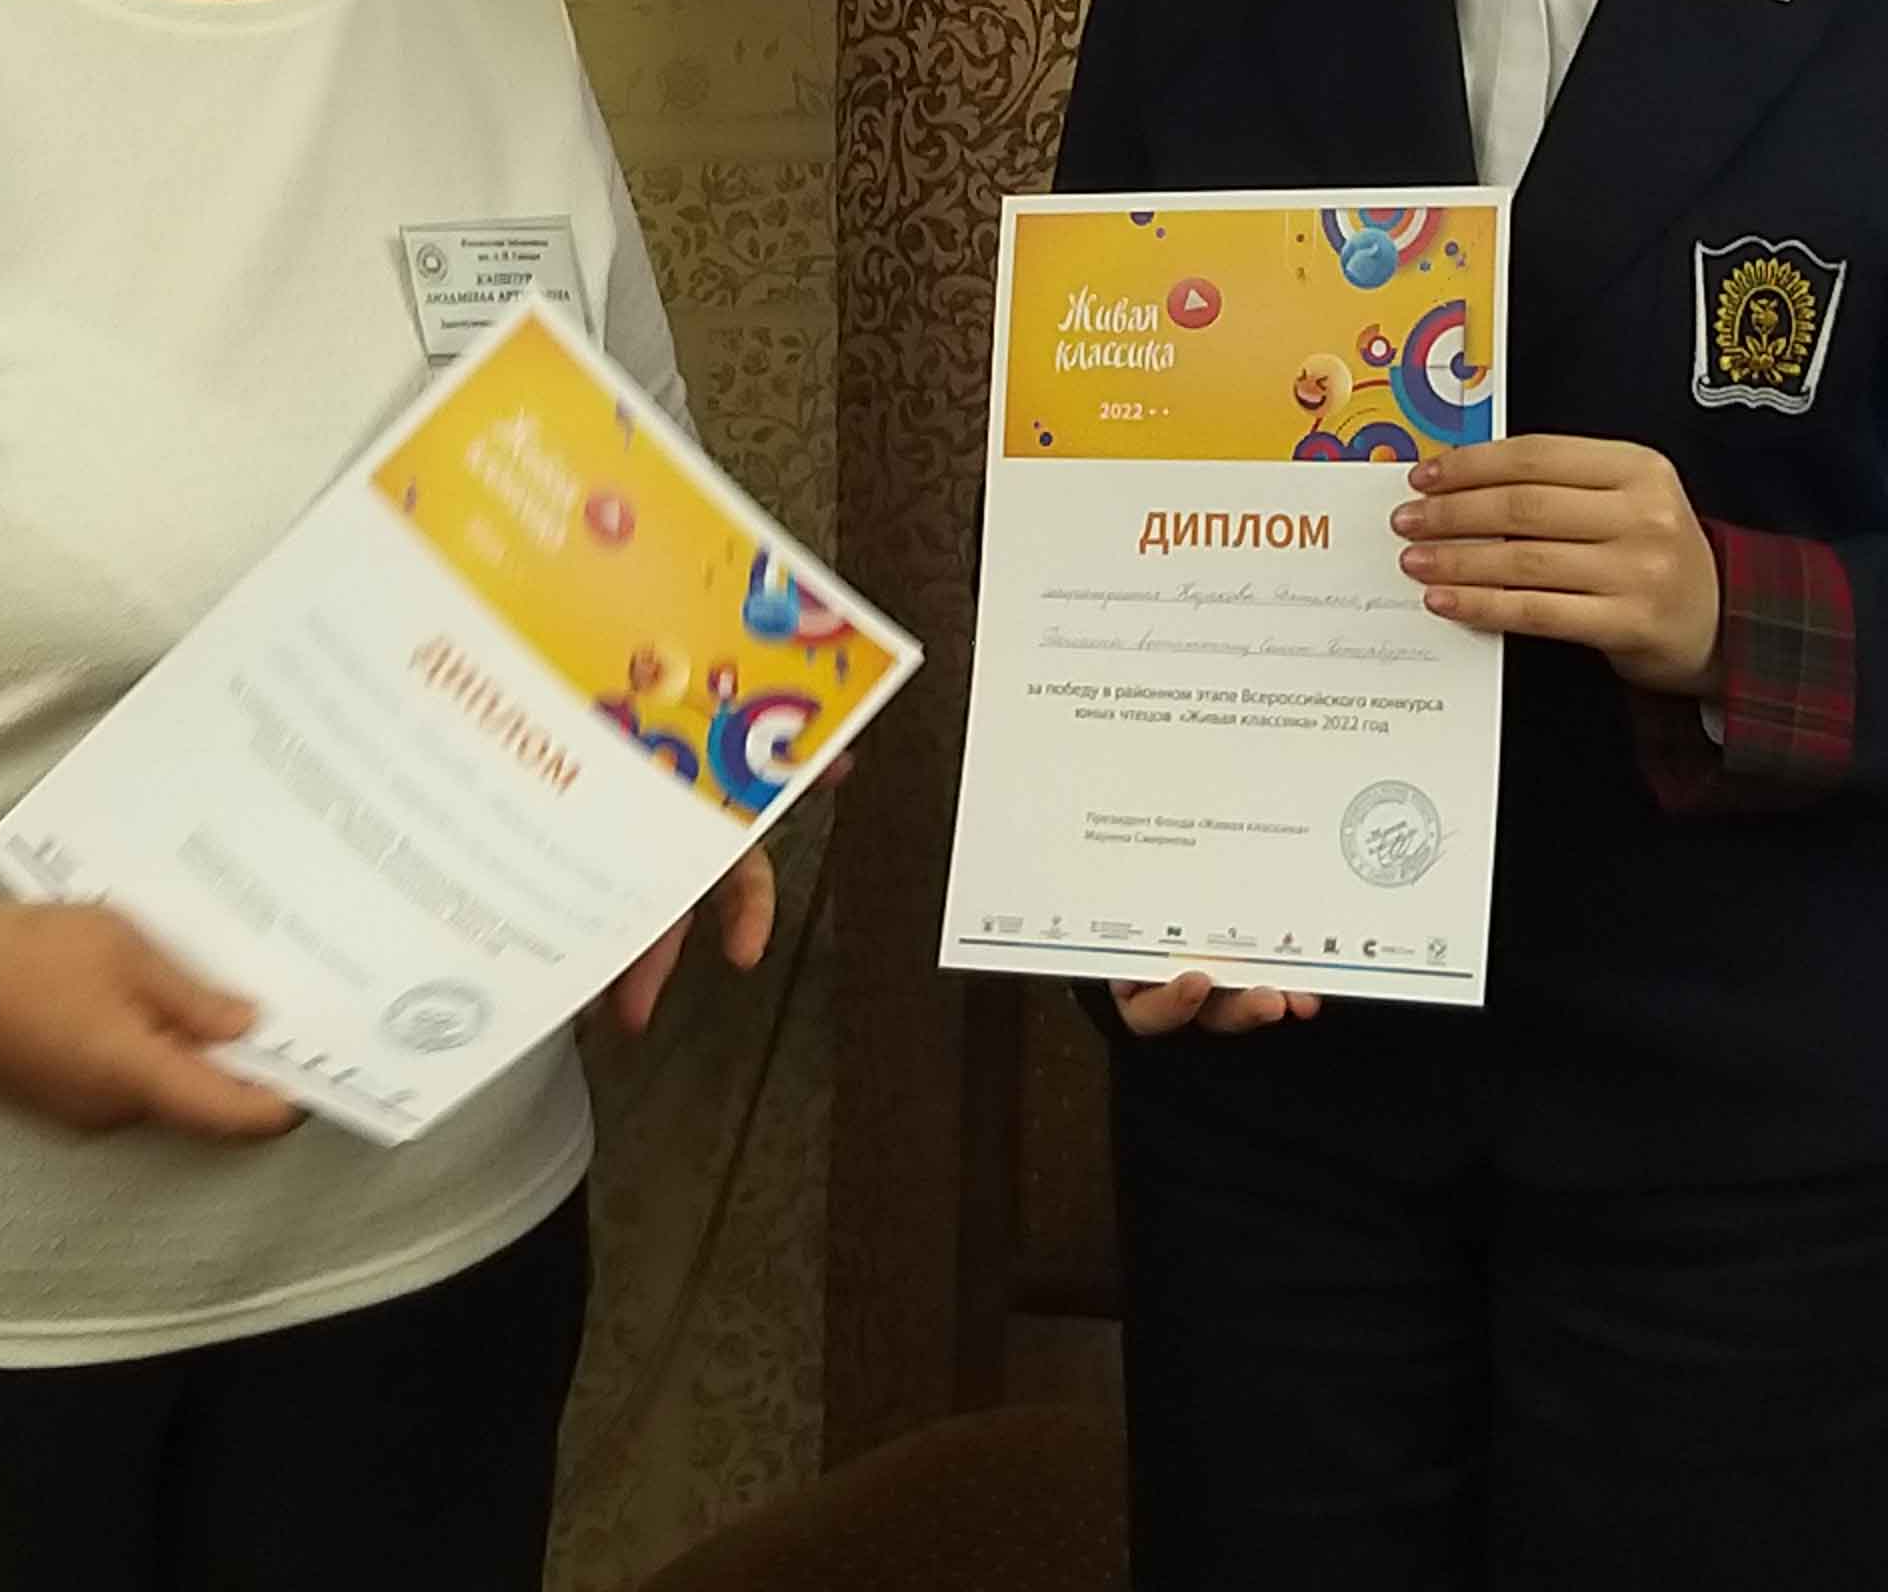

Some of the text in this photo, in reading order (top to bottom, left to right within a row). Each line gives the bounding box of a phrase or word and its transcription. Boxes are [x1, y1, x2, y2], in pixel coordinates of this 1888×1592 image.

[1057, 284, 1159, 333] Живая
[1055, 338, 1176, 373] классика
[1099, 402, 1144, 420] 2022
[1138, 511, 1330, 555] ДИПЛОМ
[1045, 682, 1099, 701] победу
[1114, 685, 1193, 704] районном
[1196, 689, 1238, 705] этапе
[1240, 688, 1368, 710] Всероссийского
[1370, 697, 1444, 713] конкурса
[1321, 716, 1359, 733] 2022
[1361, 720, 1390, 735] год
